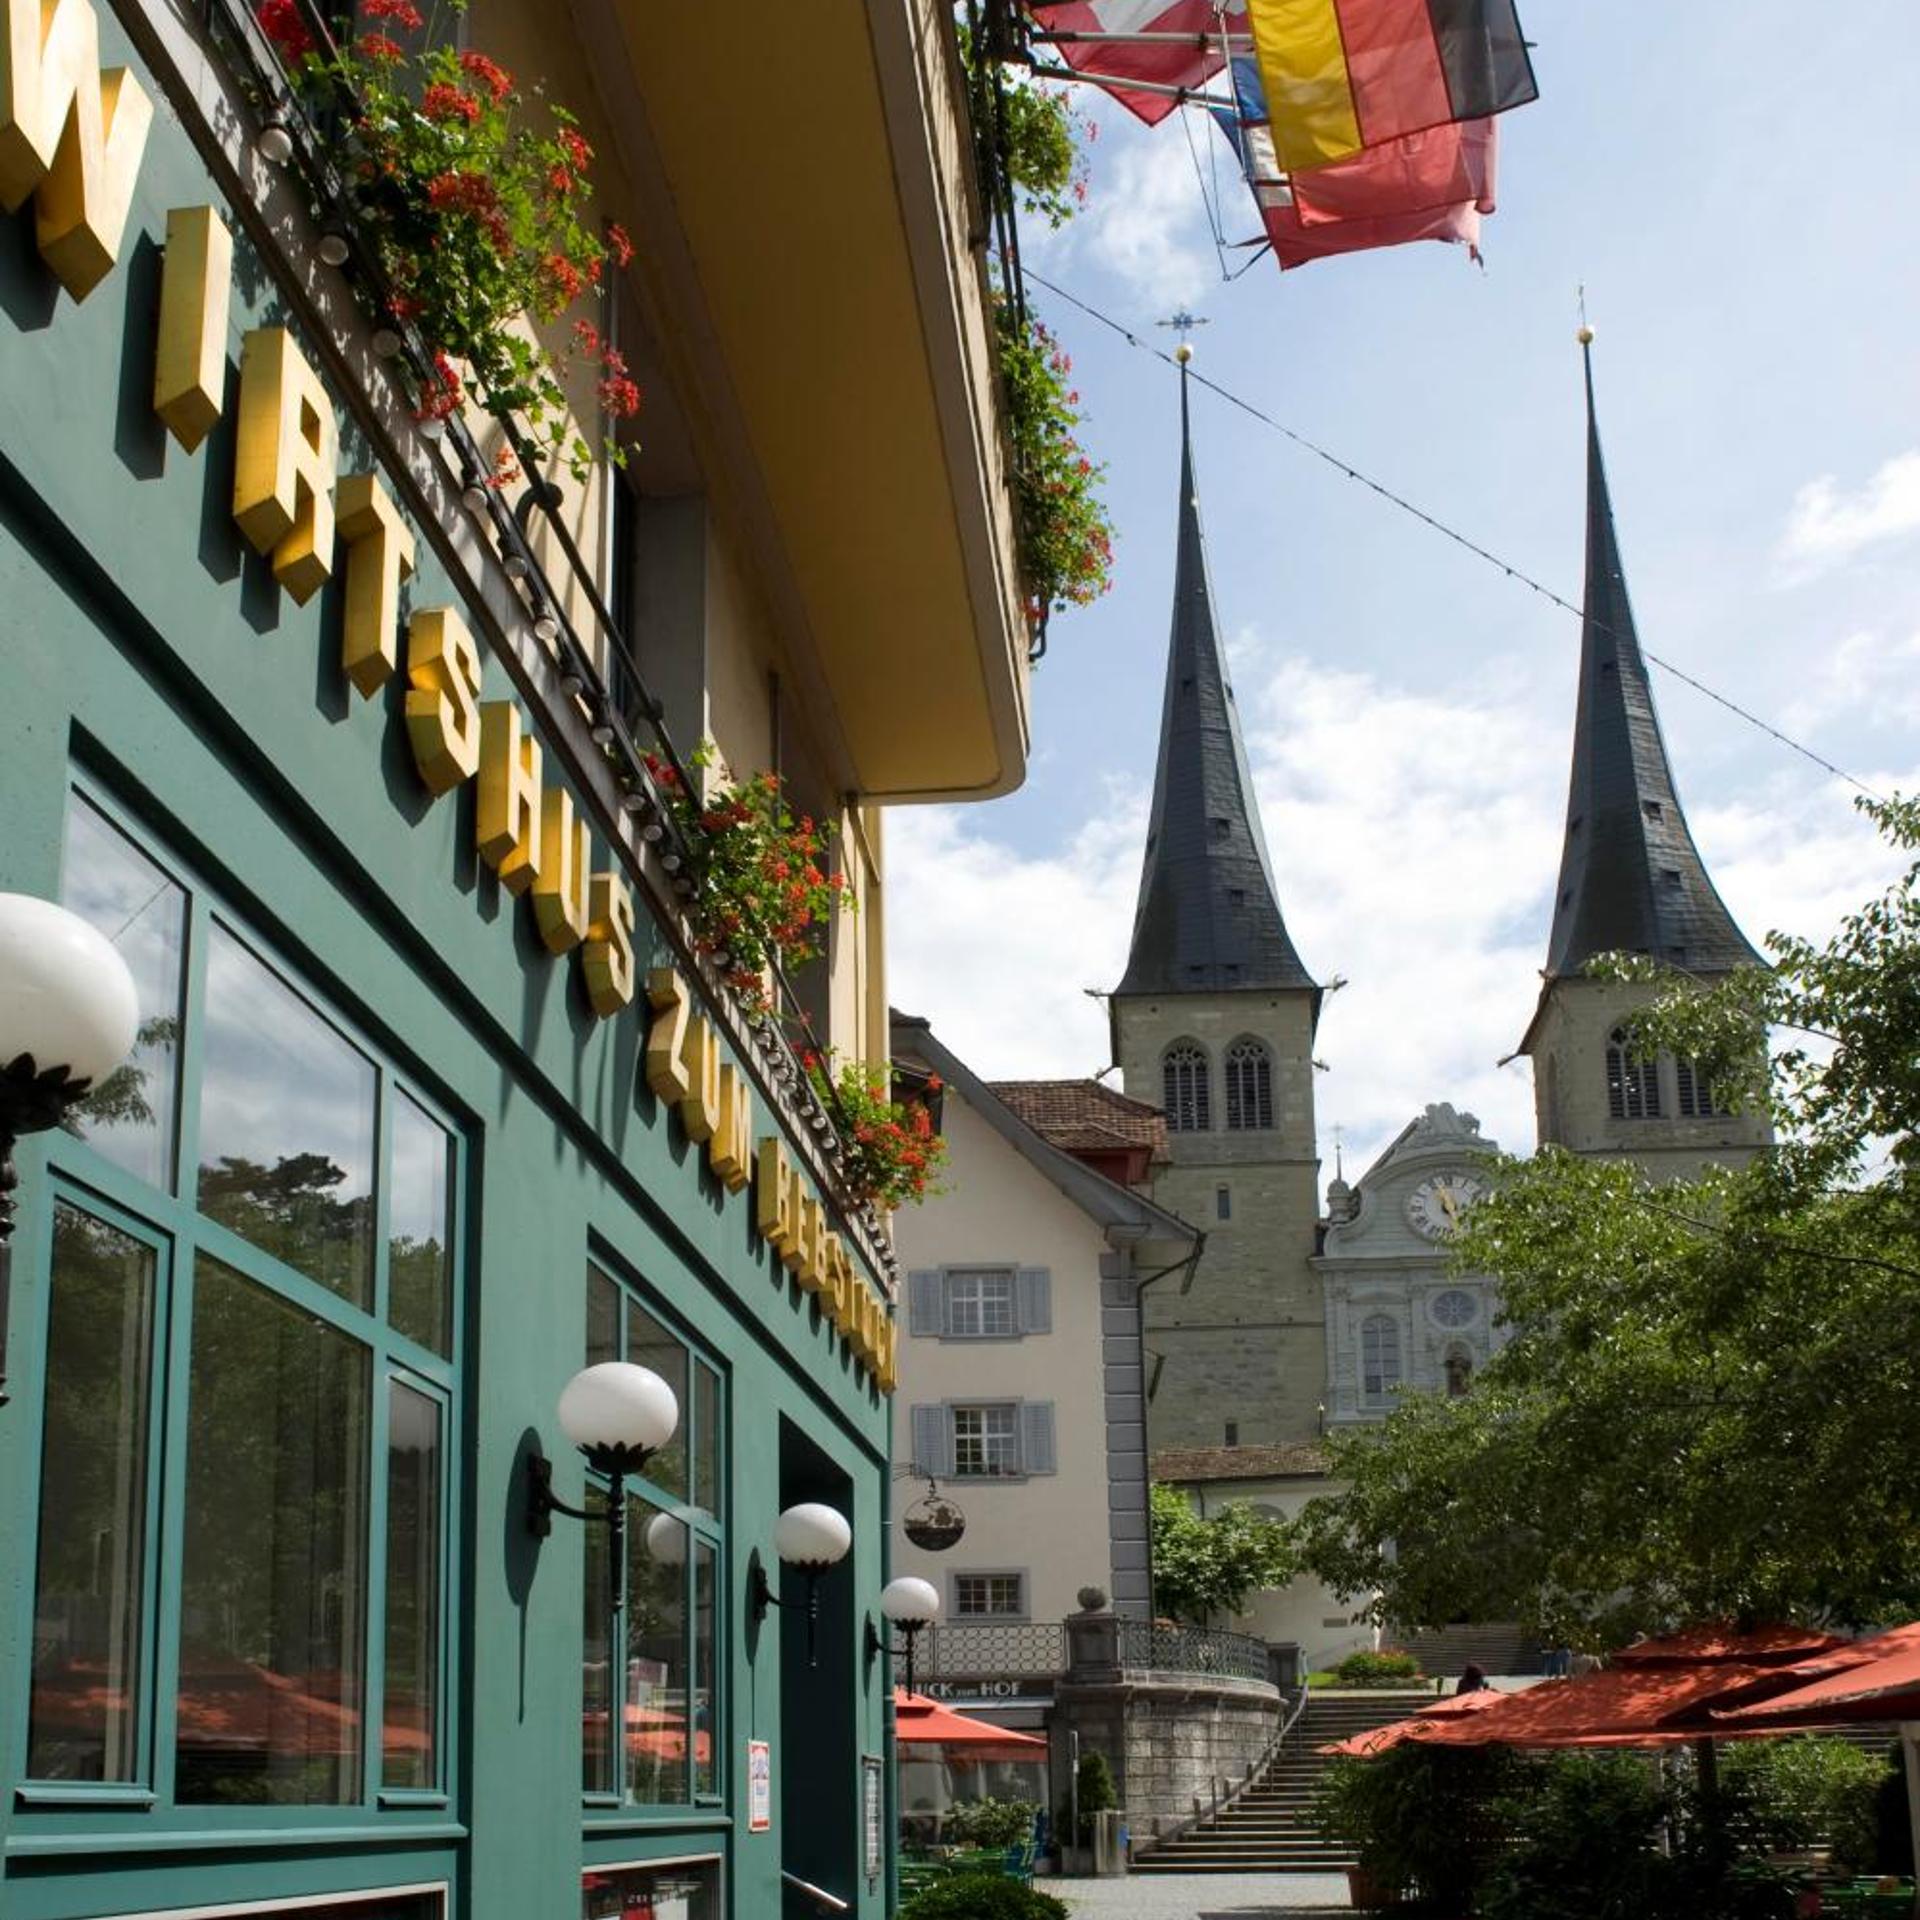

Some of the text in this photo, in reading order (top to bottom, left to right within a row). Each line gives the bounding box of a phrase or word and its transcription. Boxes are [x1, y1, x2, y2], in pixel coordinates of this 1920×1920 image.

[0, 0, 635, 1020] WIRTSHUS
[646, 967, 750, 1194] ZUM
[914, 1682, 954, 1697] UCK
[981, 1680, 1022, 1696] HOF
